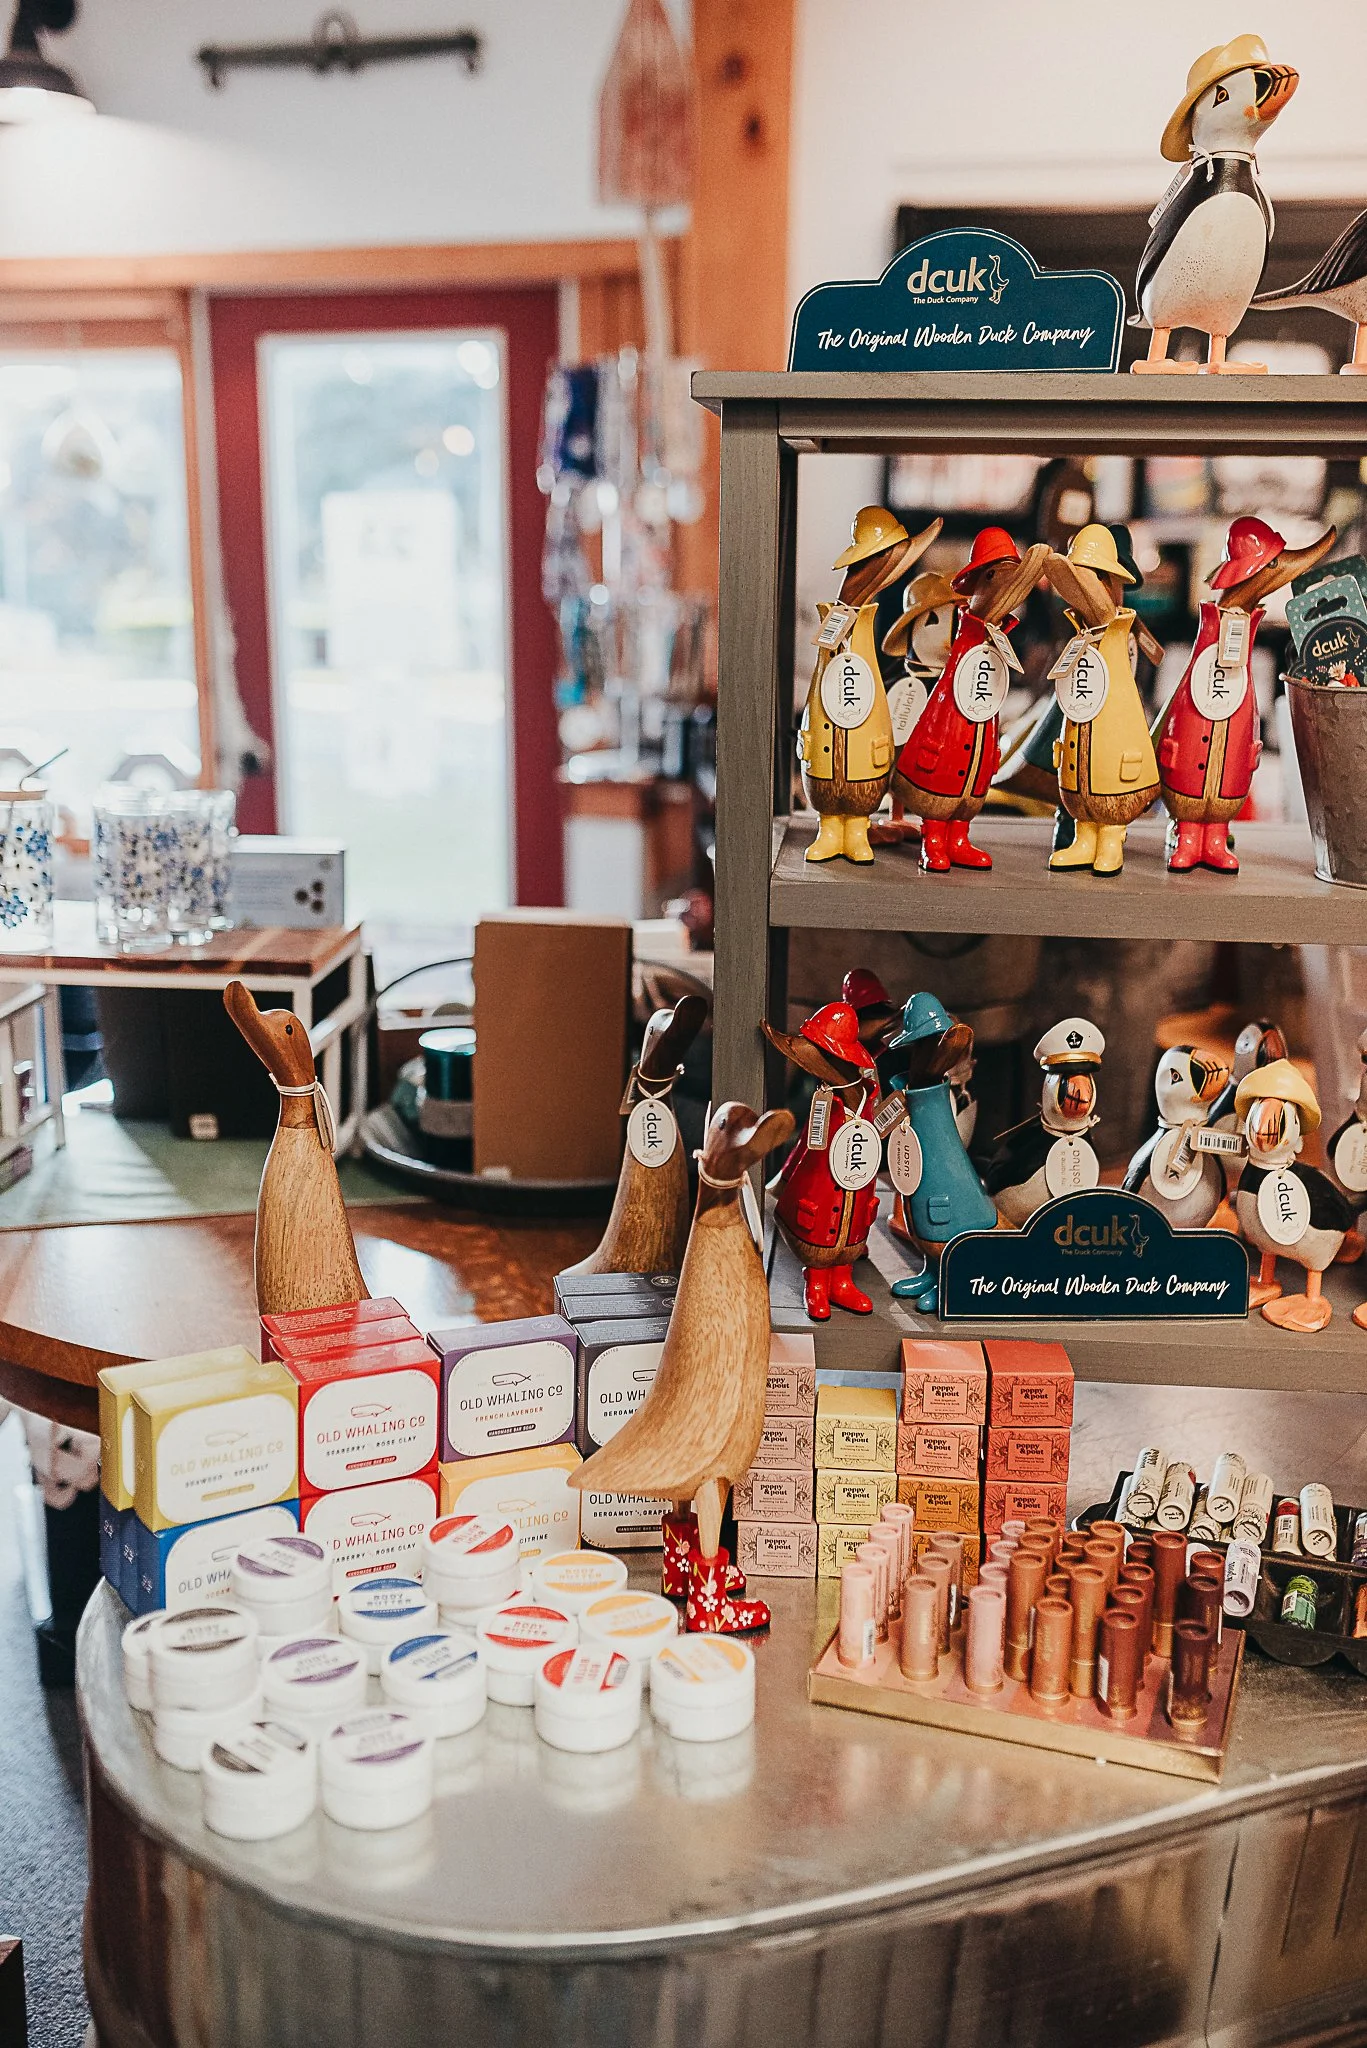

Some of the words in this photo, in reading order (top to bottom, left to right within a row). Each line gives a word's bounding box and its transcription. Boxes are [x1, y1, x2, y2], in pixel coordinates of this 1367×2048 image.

[907, 257, 987, 294] dcuk
[946, 296, 978, 304] Company
[818, 328, 844, 350] The
[849, 328, 908, 352] Original
[914, 324, 973, 347] Wooden
[978, 324, 1017, 345] Duck
[1022, 322, 1095, 348] Company
[1312, 632, 1349, 658] dcuk
[844, 666, 860, 706] dcuk
[975, 660, 995, 702] dcuk
[1076, 658, 1094, 700] dcuk
[897, 690, 916, 730] tallulah
[646, 1113, 662, 1148] dcuk
[850, 1133, 868, 1171] dcuk
[1069, 1150, 1083, 1187] joshua
[1278, 1182, 1297, 1223] dcuk
[1054, 1215, 1128, 1246] dcuk
[970, 1276, 997, 1296] The
[1001, 1276, 1059, 1299] Original
[1065, 1274, 1120, 1296] Wooden
[1126, 1276, 1162, 1295] Duck
[1165, 1274, 1230, 1300] Company
[460, 1398, 482, 1410] OLD
[487, 1388, 544, 1407] WHALING
[600, 1392, 622, 1404] OLD
[475, 1413, 504, 1422] FRENCH
[507, 1407, 543, 1417] LAVENDER
[604, 1409, 637, 1417] BERGAM
[317, 1431, 341, 1445] OLD
[345, 1420, 405, 1439] WHALING
[488, 1428, 512, 1436] HANDMADE
[171, 1461, 195, 1476] OLD
[201, 1446, 263, 1469] WHALING
[326, 1445, 366, 1456] SEABERRY
[590, 1494, 612, 1504] OLD
[617, 1493, 673, 1503] WHALI
[514, 1514, 549, 1529] LING
[346, 1528, 404, 1547] WHALING
[333, 1553, 365, 1563] ABERRY
[376, 1547, 395, 1555] ROSE
[398, 1543, 416, 1551] CLAY
[178, 1577, 202, 1594] OLD
